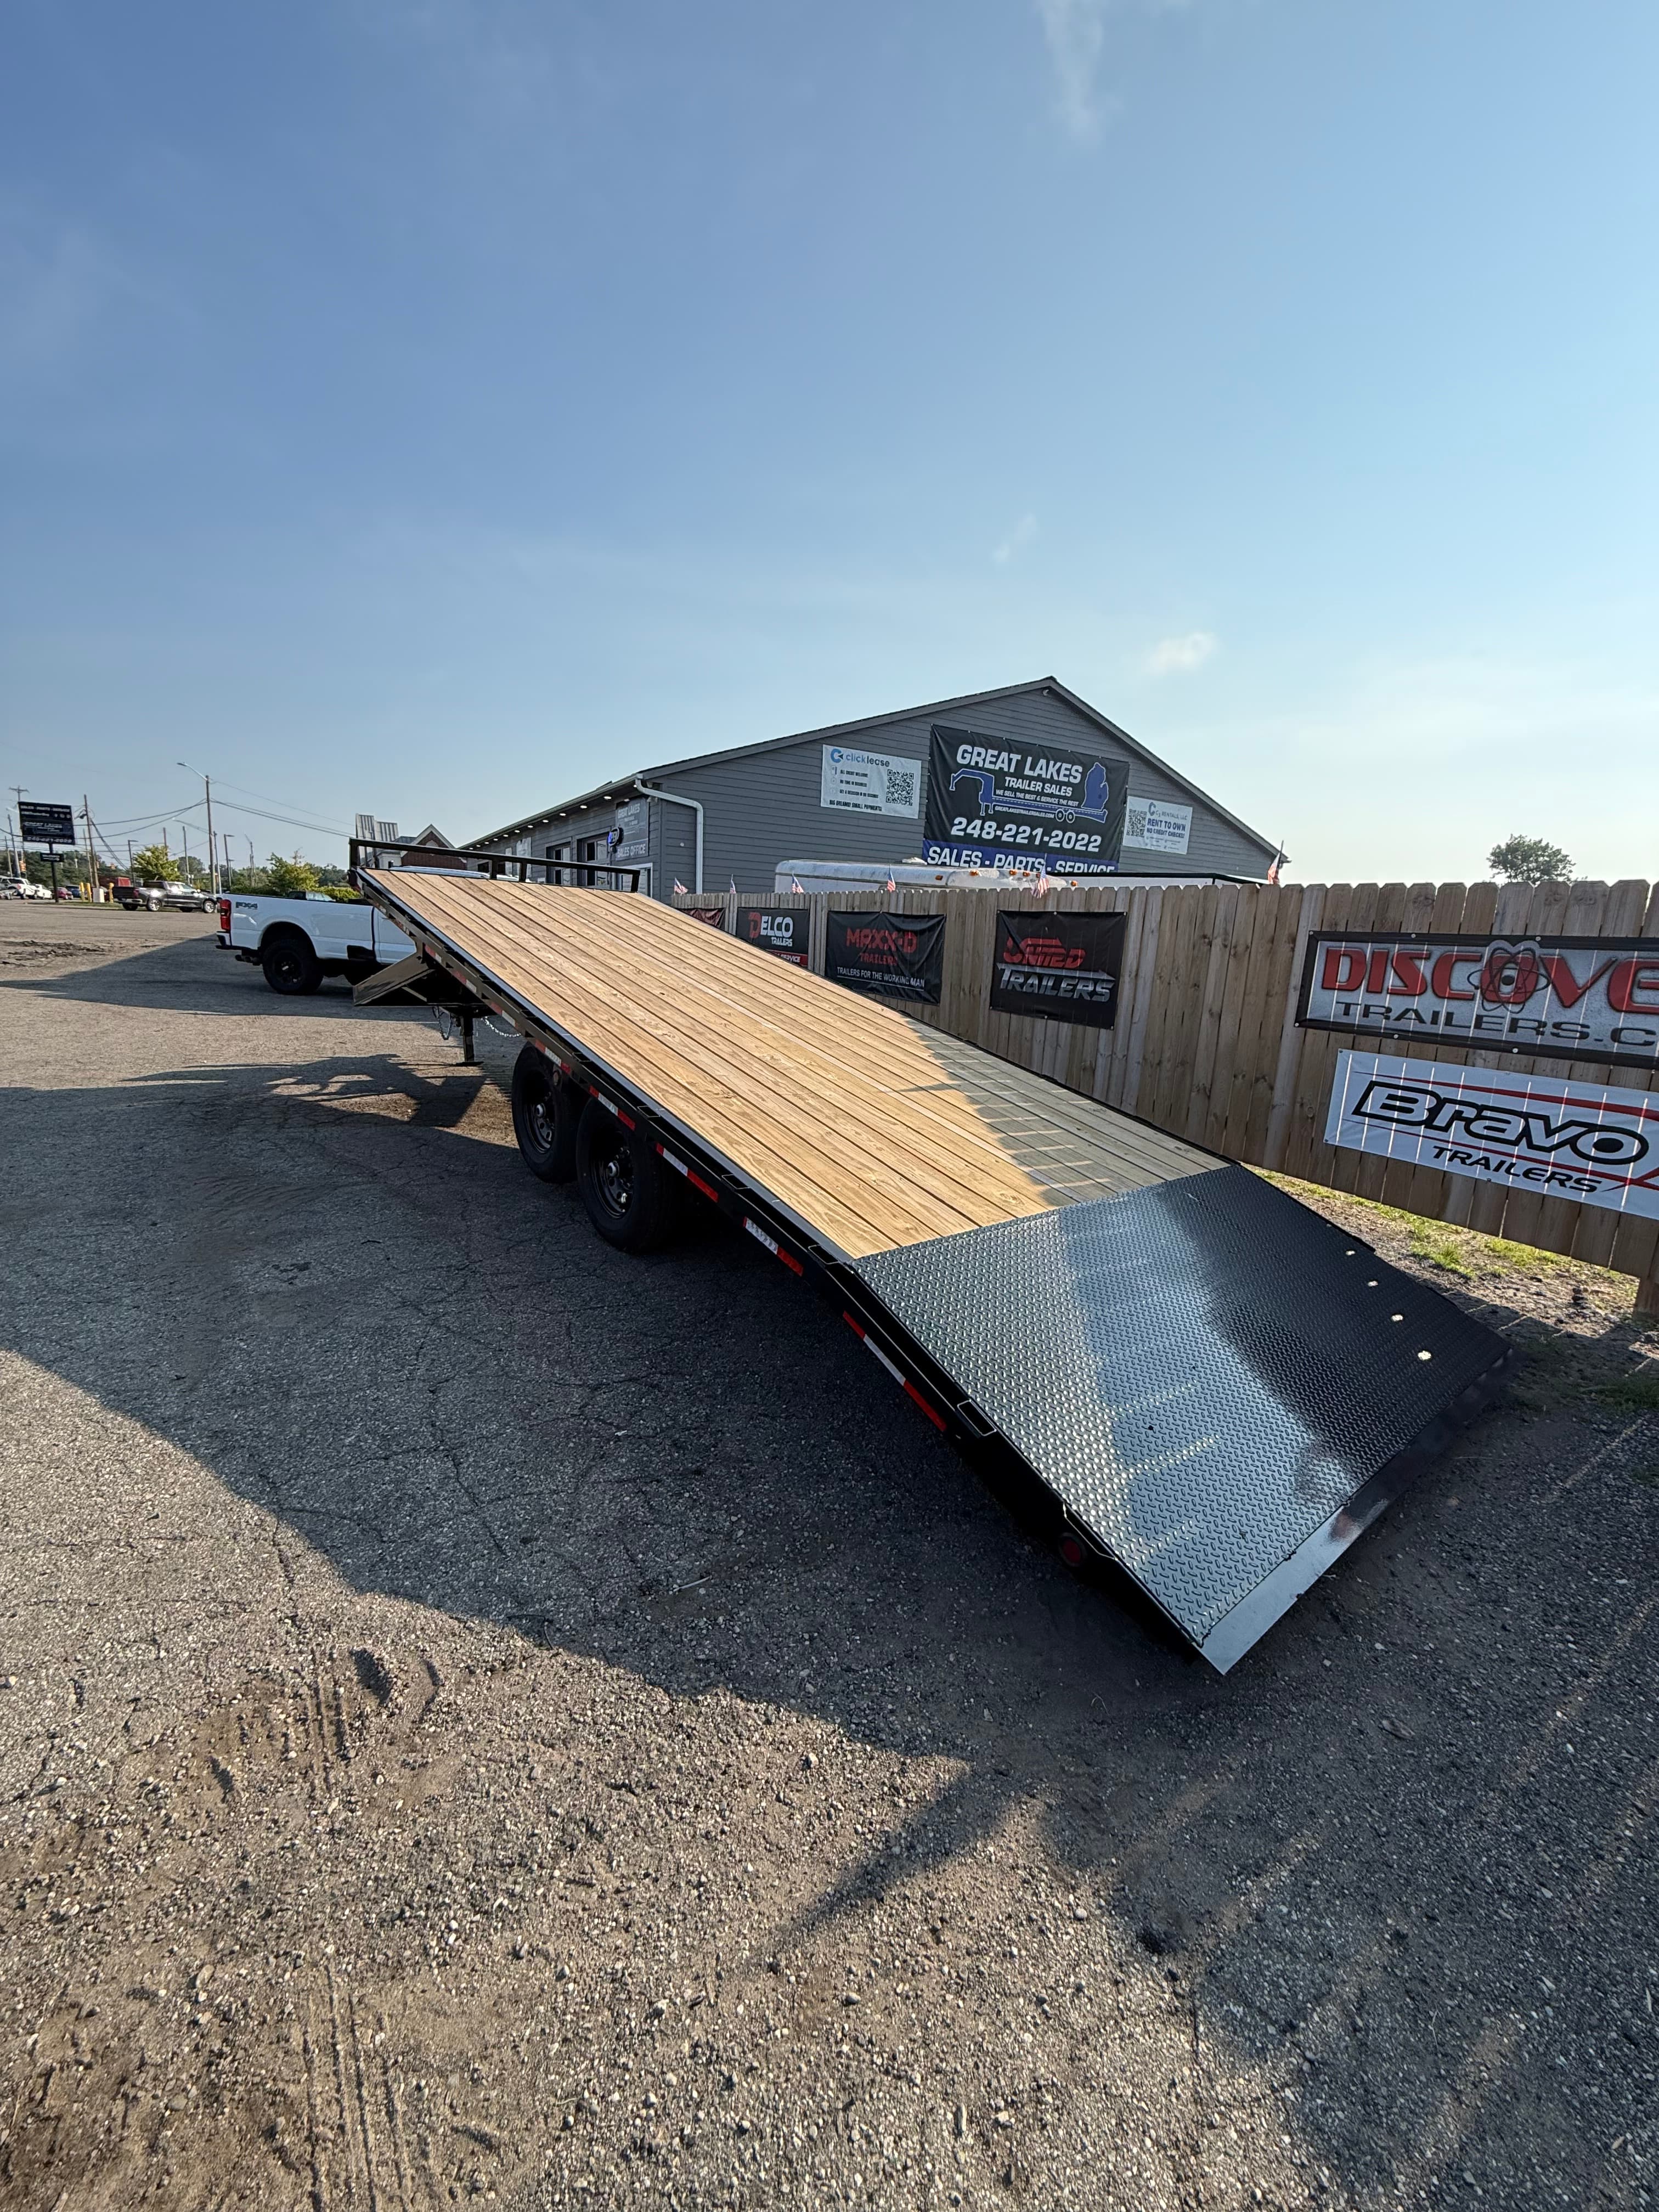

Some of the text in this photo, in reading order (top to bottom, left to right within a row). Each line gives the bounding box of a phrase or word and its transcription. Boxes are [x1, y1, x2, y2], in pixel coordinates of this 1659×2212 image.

[845, 753, 890, 767] clicklease
[957, 744, 1083, 783] GREAT LAKES
[1005, 776, 1073, 797] TRAILER SALES
[1042, 795, 1059, 804] SERVICE
[951, 817, 1102, 851] 248-221-2022
[1147, 818, 1186, 832] RENT TO OWN
[1153, 827, 1167, 836] CREDIT
[617, 843, 646, 857] SALES OFFICE
[927, 847, 983, 868] SALES
[994, 853, 1045, 873] PARTS
[235, 902, 258, 910] FX4
[748, 912, 793, 939] DELCO
[771, 936, 793, 947] TRAILERS
[1003, 936, 1086, 968] UNITED
[860, 952, 898, 966] TRAILERS
[837, 967, 860, 977] TRAILERS
[872, 972, 882, 980] THE
[883, 973, 909, 985] WORKING
[910, 977, 924, 988] MAN
[996, 962, 1115, 1002] TRAILERS
[1321, 947, 1659, 1014] DISCOVE
[1336, 1001, 1656, 1046] TRAILERS.C
[1352, 1080, 1649, 1165] Bravo
[1432, 1145, 1602, 1193] TRAILERS
